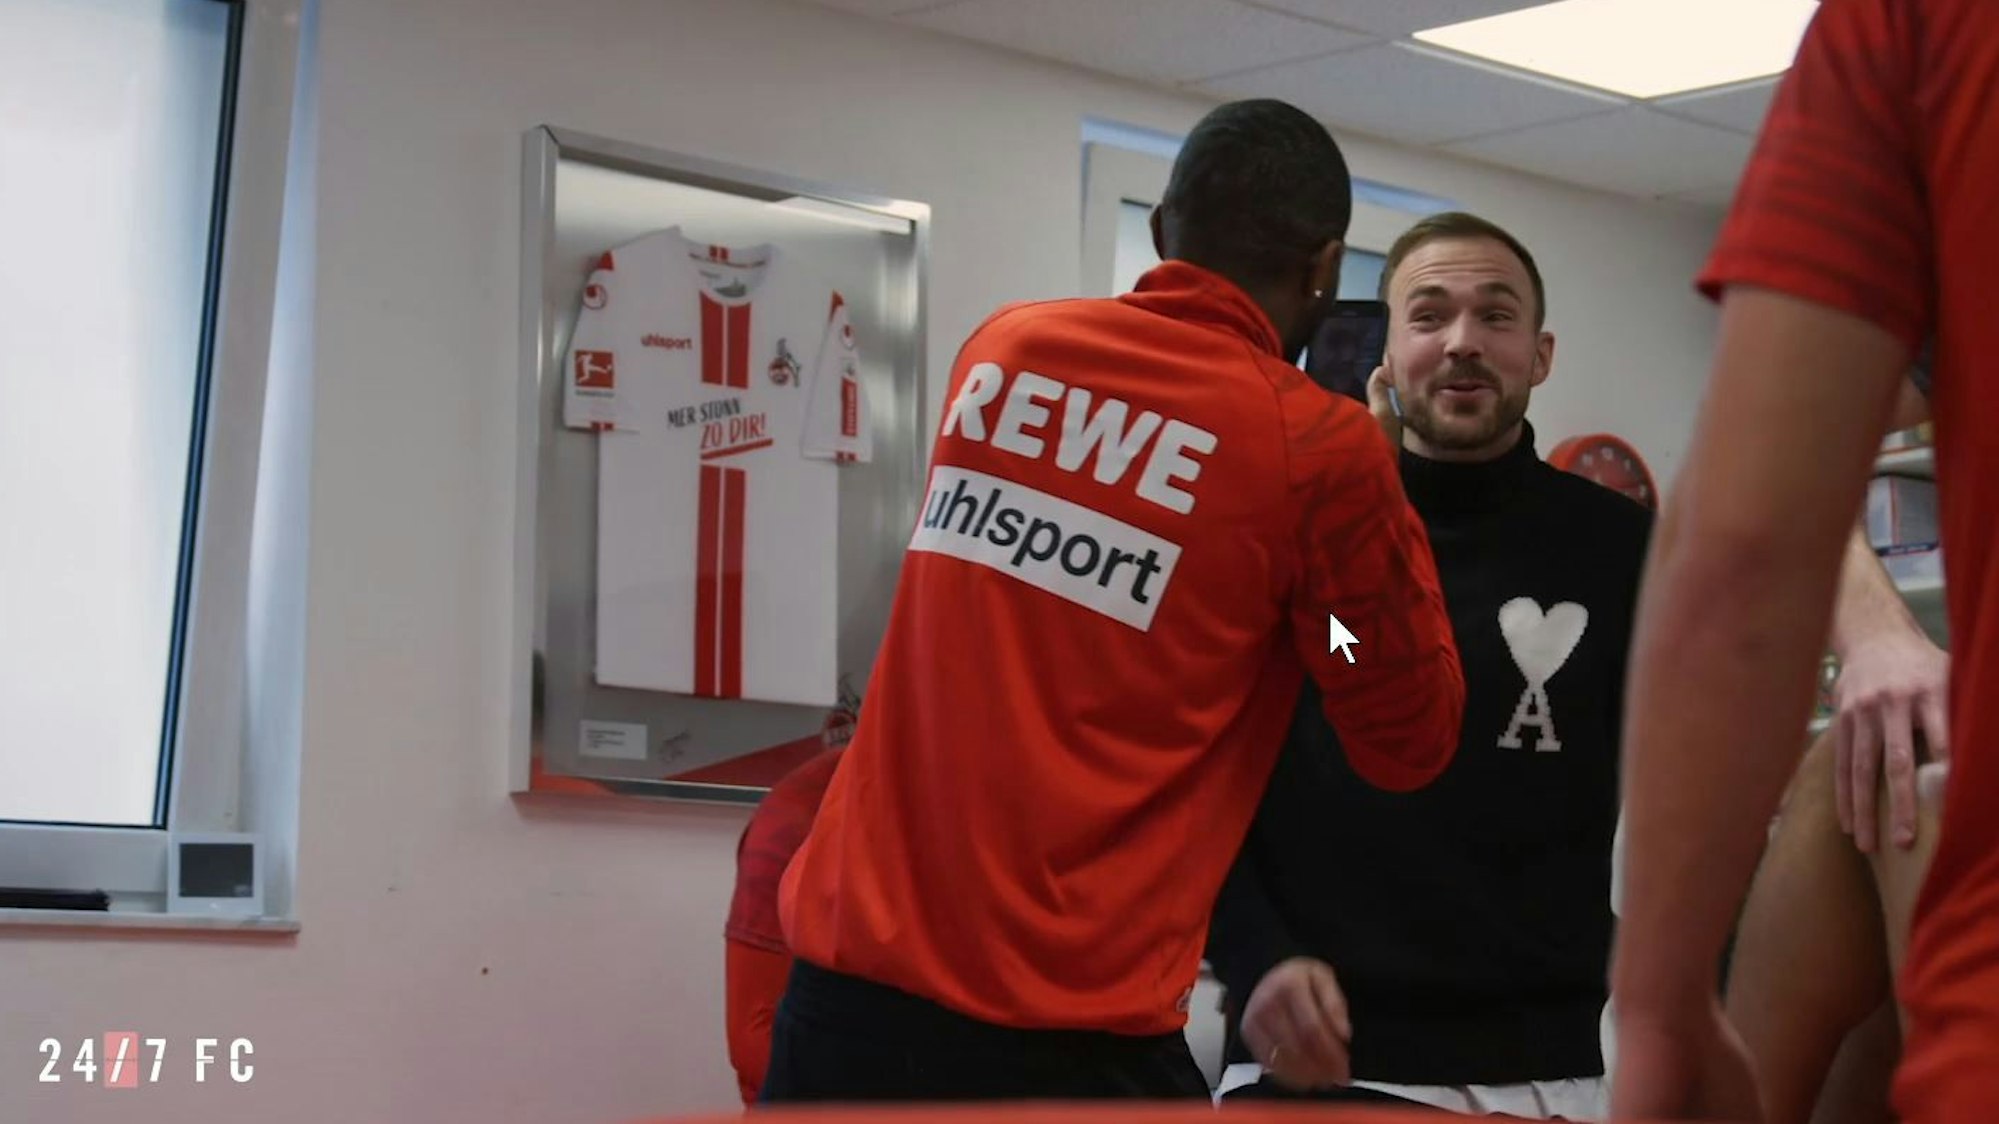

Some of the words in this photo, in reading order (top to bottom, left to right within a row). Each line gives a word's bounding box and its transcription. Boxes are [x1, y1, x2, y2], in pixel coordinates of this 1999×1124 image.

[641, 333, 692, 350] uhlsport
[668, 406, 696, 428] MER
[700, 422, 722, 449] ZO
[729, 413, 765, 443] DIR!
[942, 362, 1218, 515] REWE
[923, 479, 1161, 604] uhlsport
[1497, 678, 1562, 752] A
